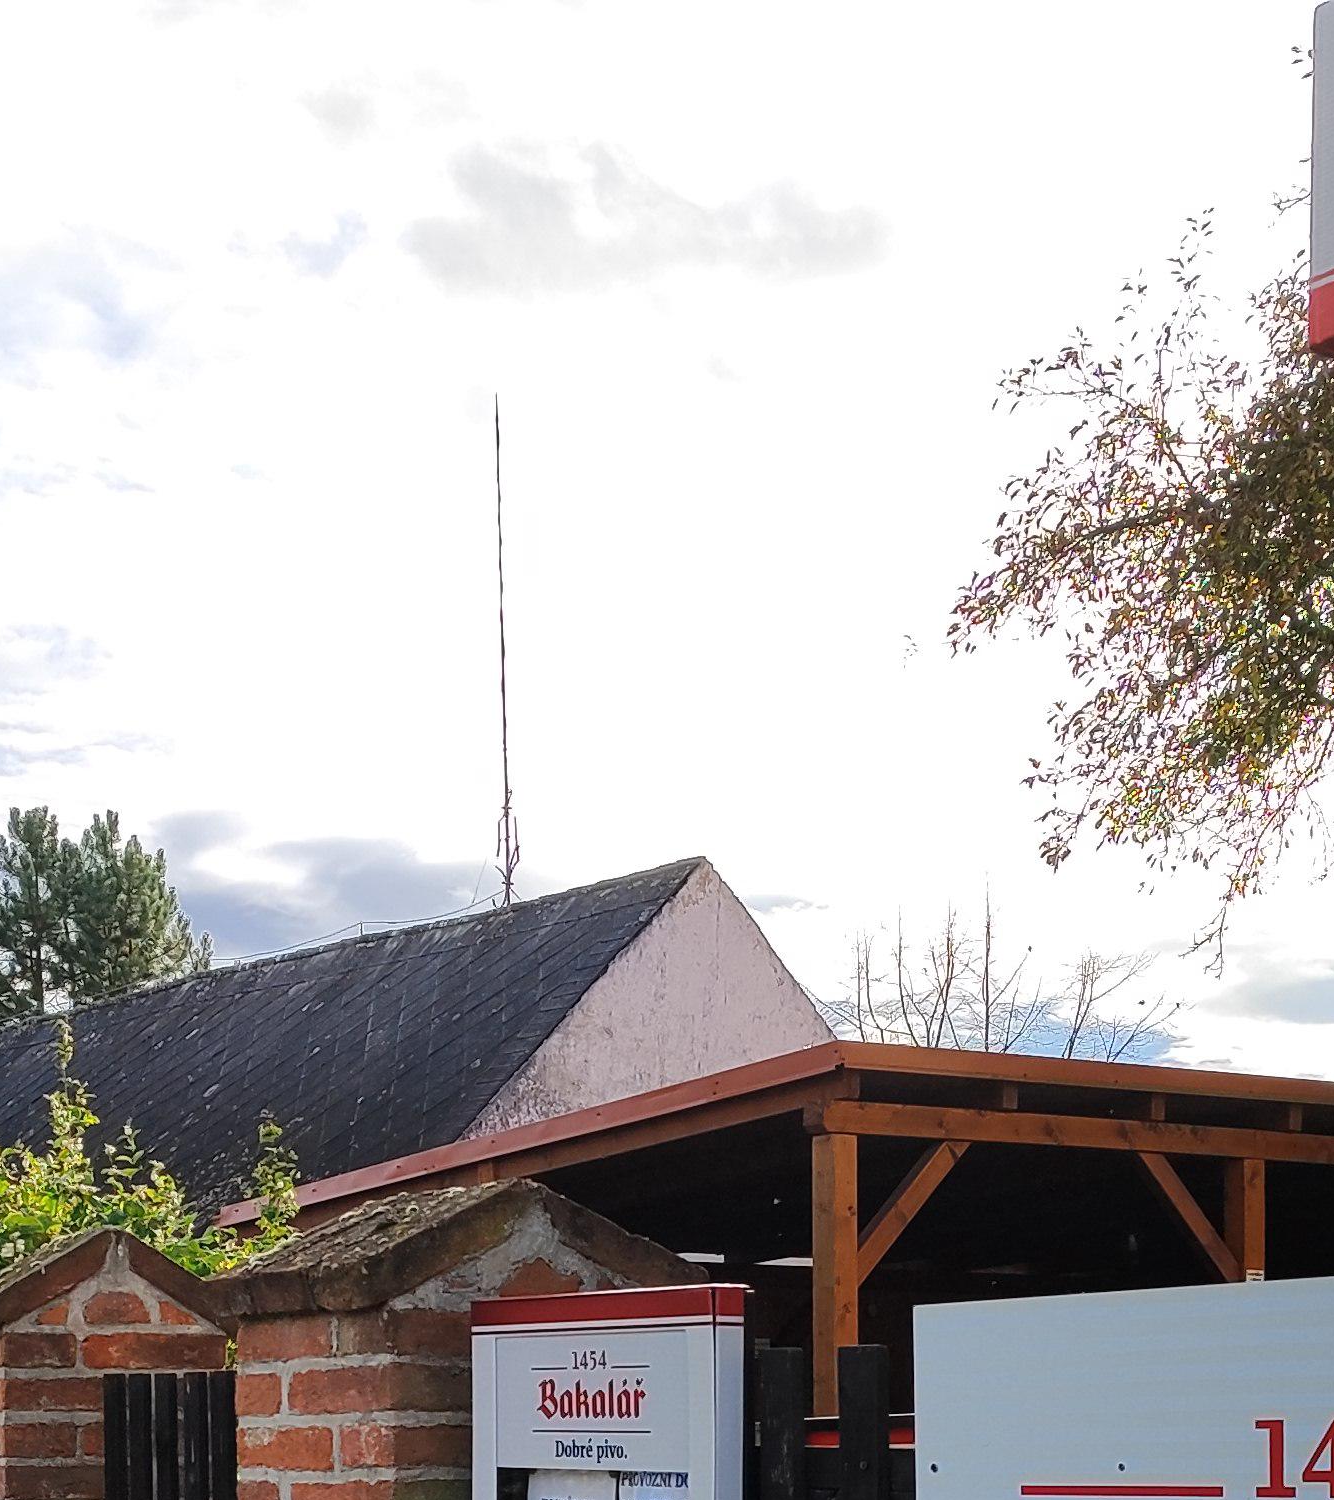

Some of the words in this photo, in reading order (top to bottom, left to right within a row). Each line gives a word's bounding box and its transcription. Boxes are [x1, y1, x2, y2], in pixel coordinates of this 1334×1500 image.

[571, 1350, 607, 1371] 1454
[536, 1377, 647, 1420] Bakalář
[555, 1438, 593, 1458] Dobré
[597, 1439, 628, 1464] pivo.
